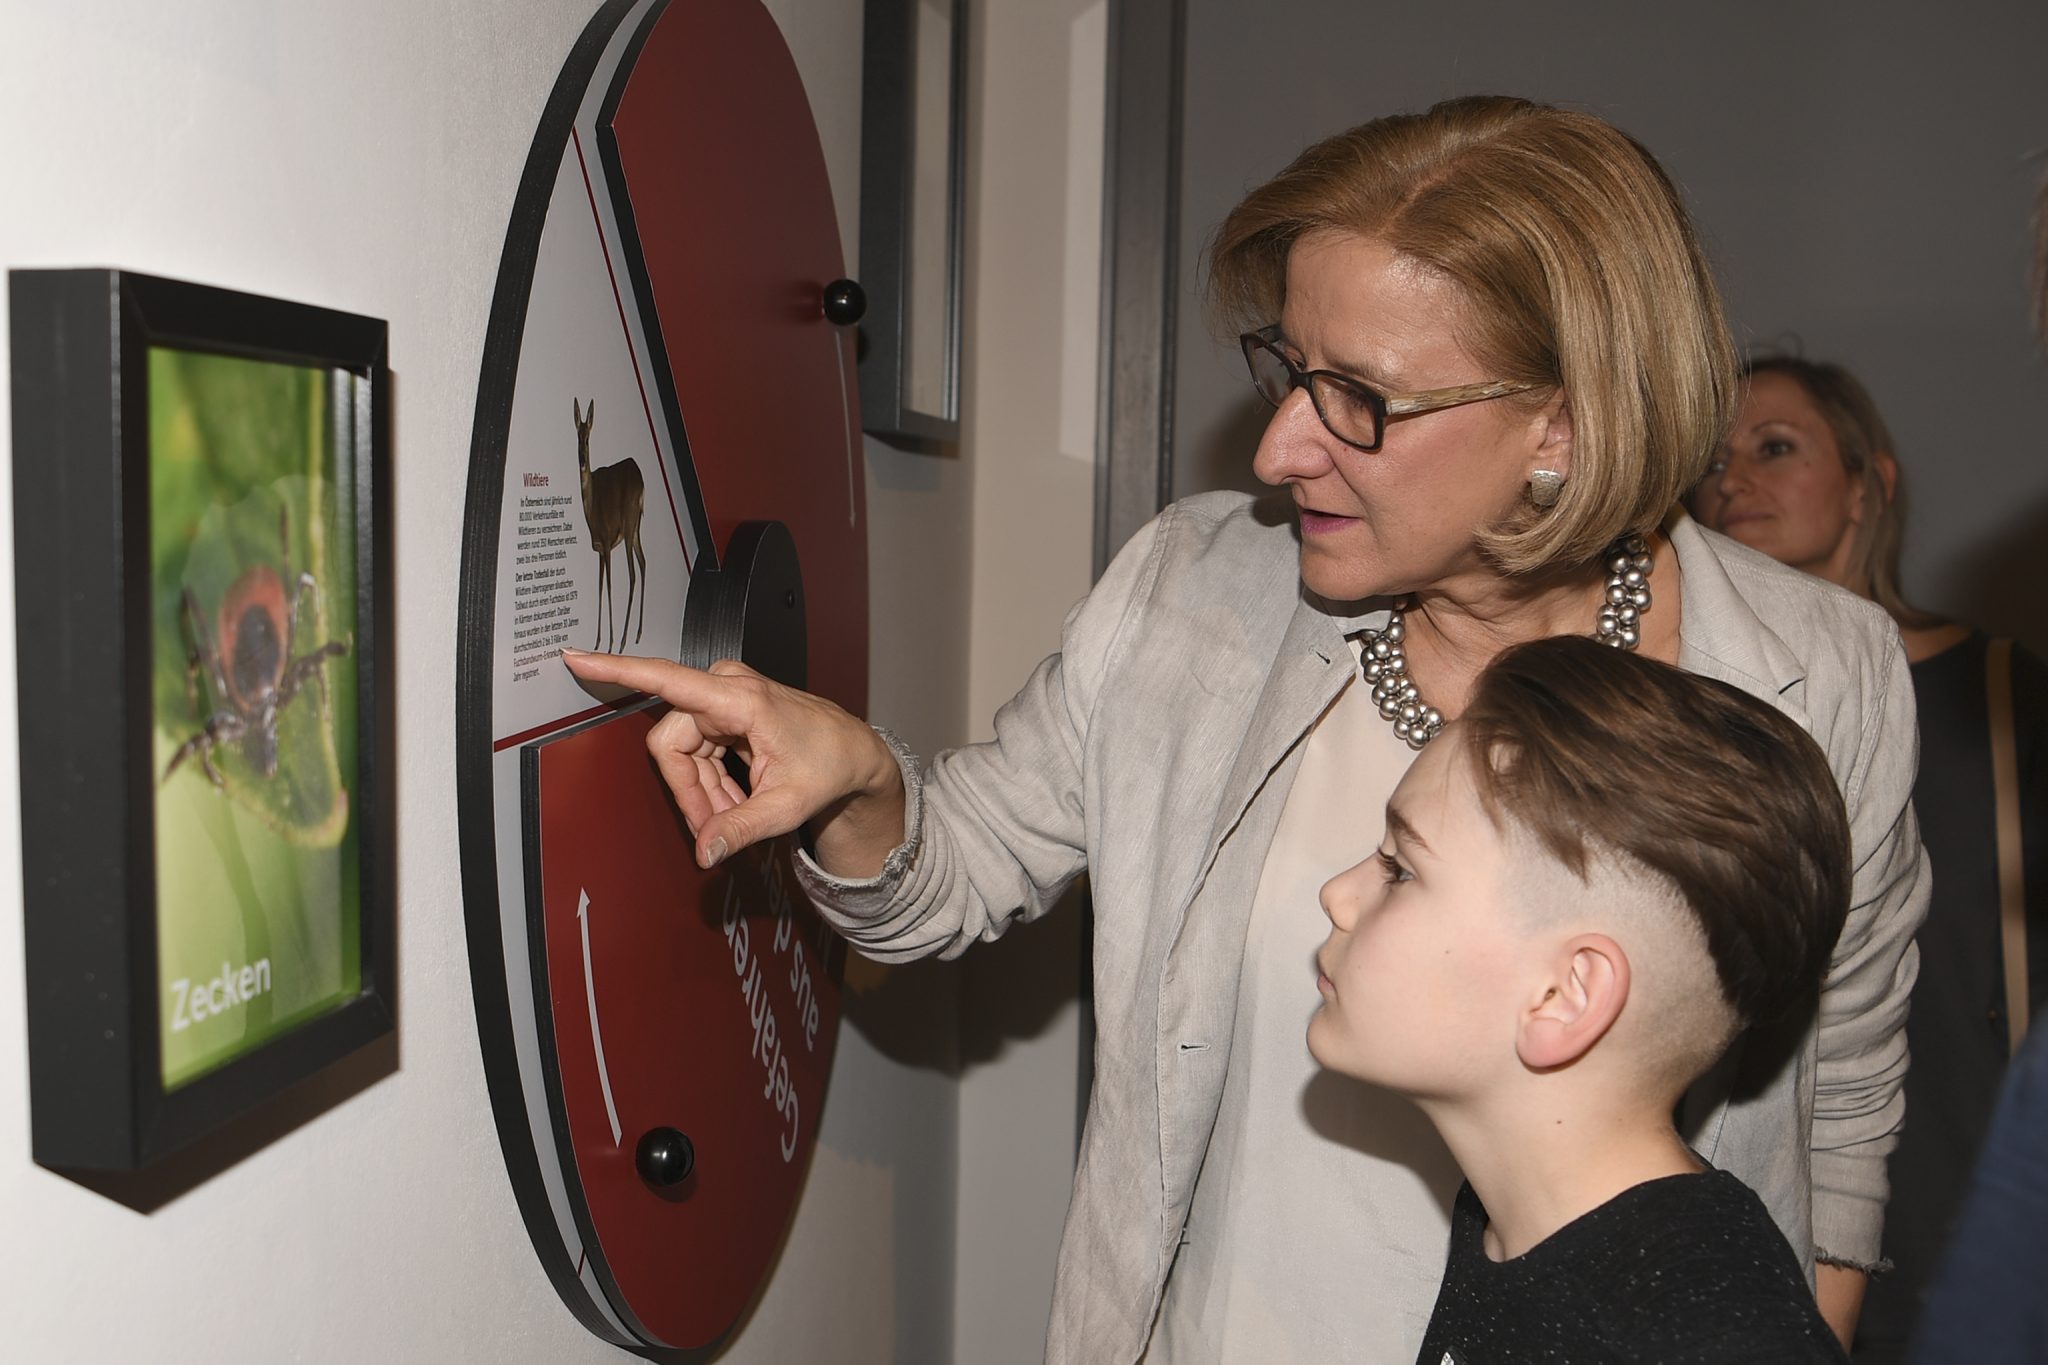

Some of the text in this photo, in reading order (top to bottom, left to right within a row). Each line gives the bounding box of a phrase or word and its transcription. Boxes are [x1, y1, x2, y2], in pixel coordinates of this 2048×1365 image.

[523, 472, 549, 488] Wildtiere
[520, 498, 525, 507] In
[525, 496, 544, 507] Österreich
[551, 496, 563, 507] jährlich
[564, 496, 572, 505] rund
[532, 509, 558, 520] Verkehrsunfälle
[518, 526, 536, 536] Wildtieren
[563, 522, 573, 531] Dabei
[517, 541, 530, 550] werden
[531, 540, 540, 548] rund
[547, 537, 564, 546] Menschen
[516, 556, 524, 565] zwei
[538, 552, 554, 562] Personen
[523, 572, 533, 581] letzte
[533, 568, 549, 579] Todesfall
[555, 568, 566, 576] durch
[515, 586, 531, 596] Wildtiere
[531, 583, 554, 594] übertragenen
[514, 600, 528, 610] Tollwut
[529, 599, 539, 608] durch
[539, 598, 549, 606] einen
[549, 594, 565, 604] Fuchsbiss
[514, 616, 518, 625] in
[519, 614, 532, 624] Kärnten
[557, 606, 571, 616] Darüber
[514, 630, 526, 639] hinaus
[526, 626, 540, 636] wurden
[551, 622, 563, 631] letzten
[568, 617, 579, 627] Jahren
[513, 639, 542, 654] durchschnittlich
[554, 634, 562, 644] Fälle
[513, 671, 521, 682] Jahr
[170, 957, 271, 1032] Zecken
[790, 940, 819, 1052] aus
[723, 873, 799, 1163] Gefahren
